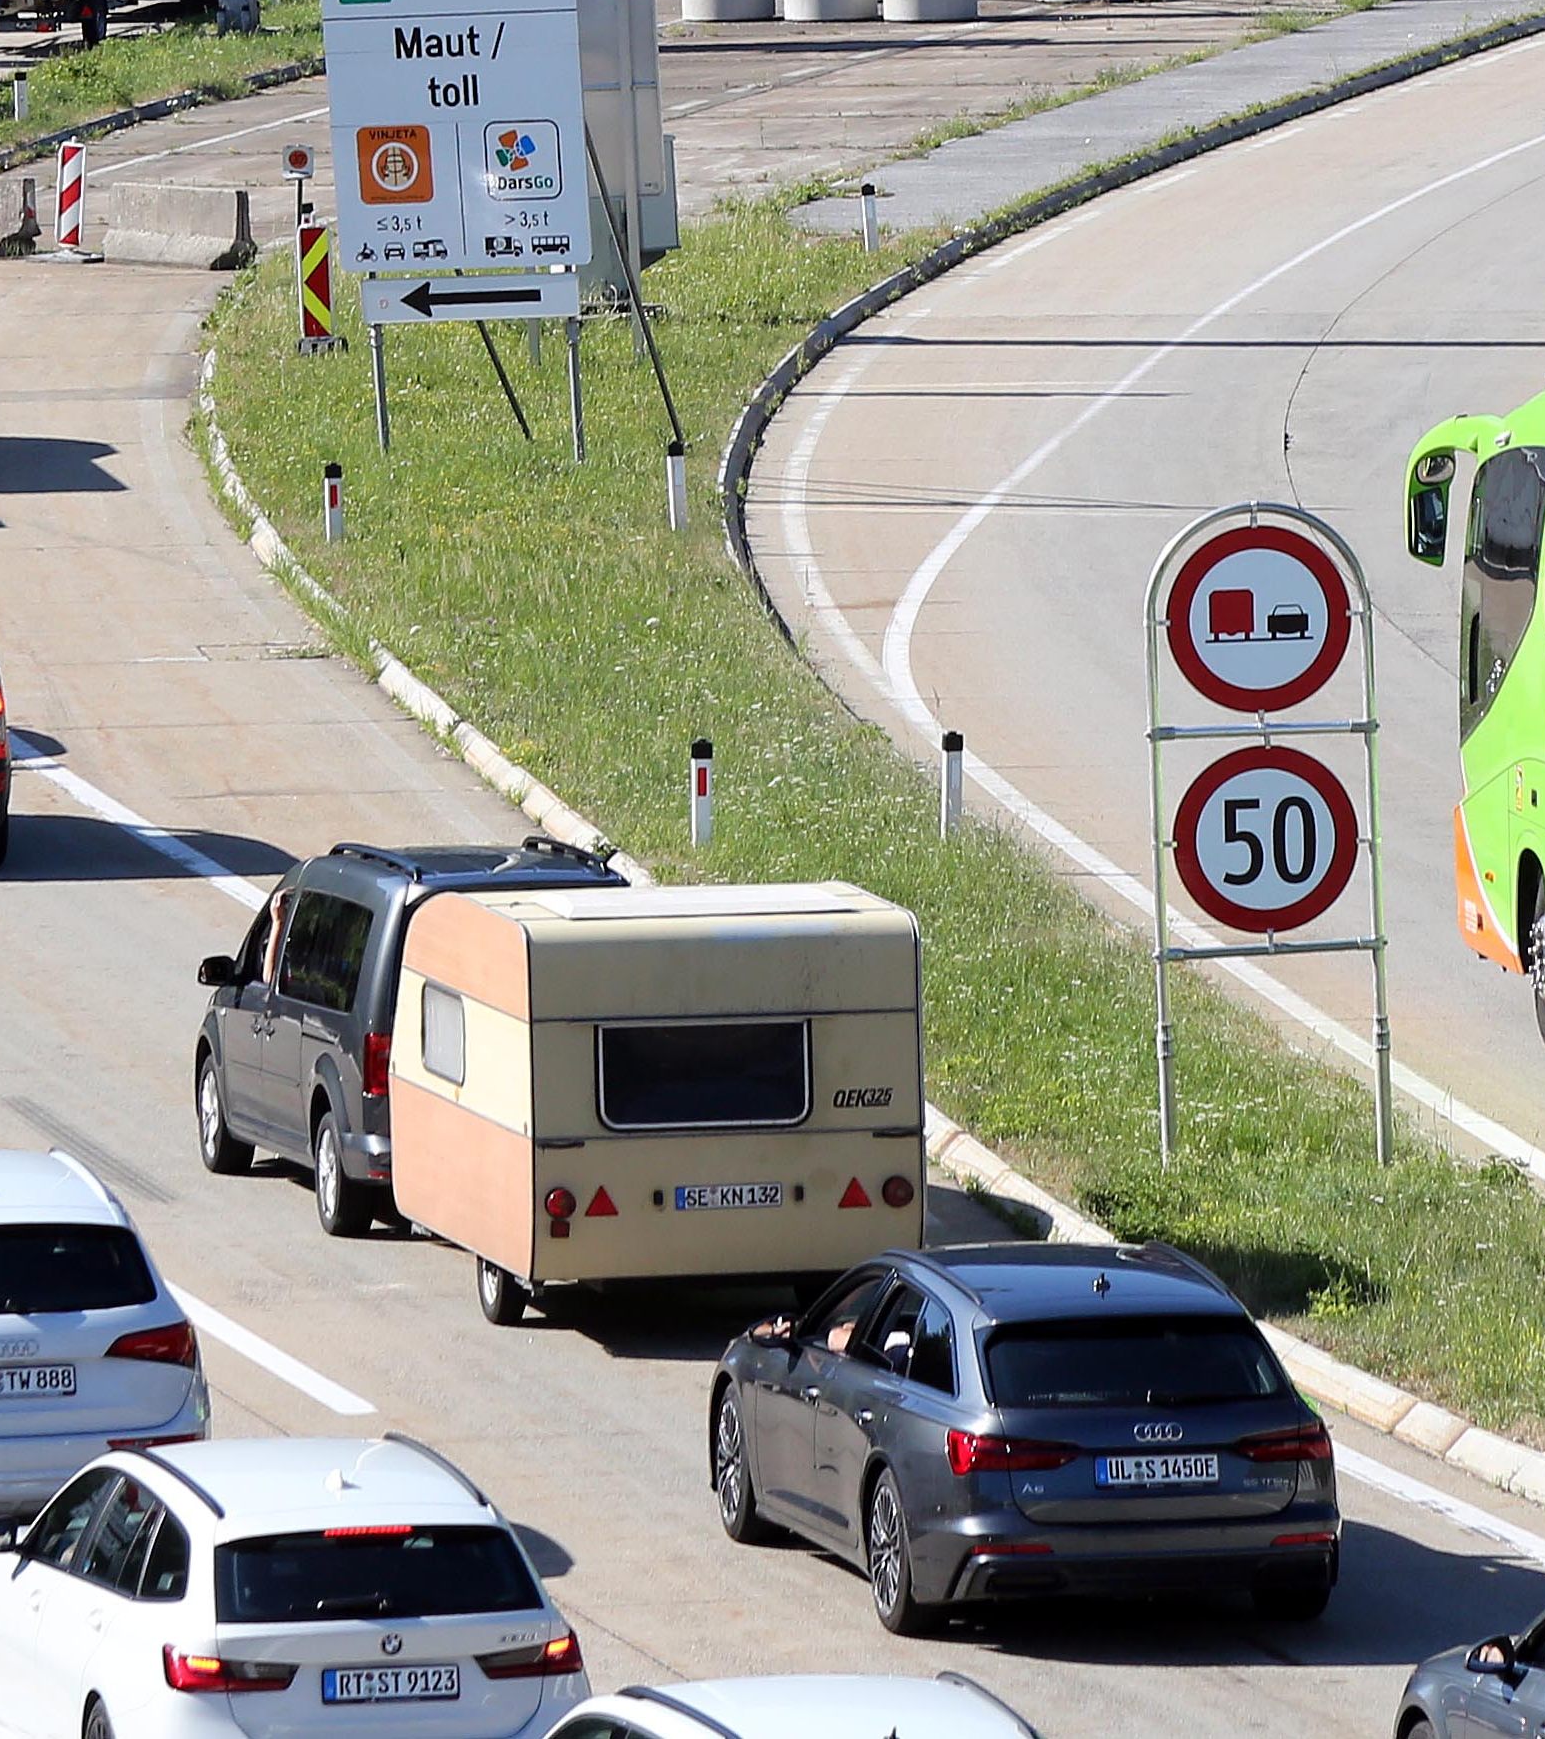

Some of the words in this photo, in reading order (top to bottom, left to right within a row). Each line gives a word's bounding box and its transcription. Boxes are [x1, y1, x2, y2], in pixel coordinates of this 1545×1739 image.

[394, 25, 481, 60] Maut
[427, 73, 480, 108] toll
[368, 128, 417, 141] VINJETA
[497, 175, 554, 191] DarsGo
[520, 211, 540, 230] 3,5
[543, 209, 550, 227] t
[1222, 796, 1318, 887] 50
[685, 1187, 709, 1207] SE
[720, 1187, 745, 1206] KN
[747, 1185, 780, 1204] 132
[5, 1368, 33, 1392] TW
[35, 1367, 73, 1390] 888
[1108, 1457, 1133, 1481] UL
[1145, 1458, 1157, 1479] S
[1160, 1456, 1217, 1479] 1450E
[339, 1672, 366, 1696] RT
[377, 1671, 402, 1693] ST
[407, 1668, 457, 1693] 9123
